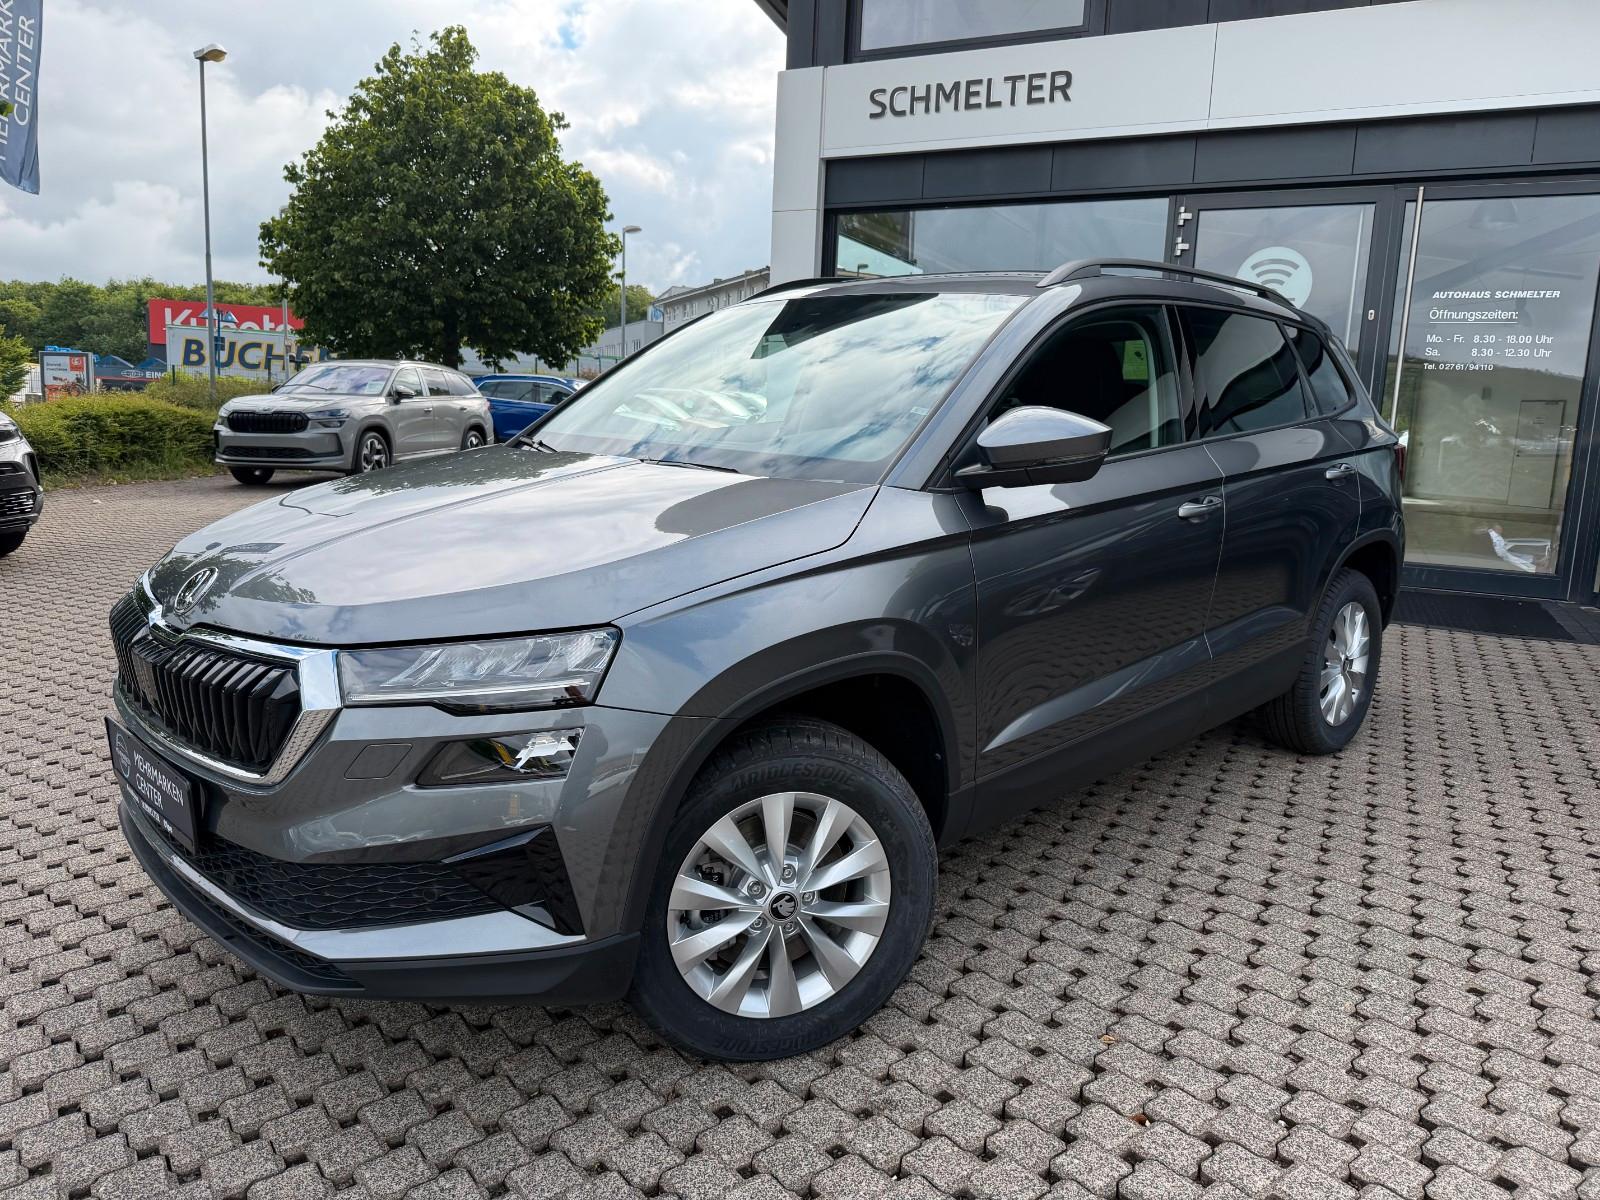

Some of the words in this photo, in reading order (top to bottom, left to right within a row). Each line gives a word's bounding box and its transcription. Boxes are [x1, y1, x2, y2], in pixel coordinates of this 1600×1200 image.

[13, 15, 35, 126] CENTER
[869, 70, 1073, 119] SCHMELTER
[1432, 290, 1491, 299] AUTOHAUS
[1494, 290, 1561, 299] SCHMELTER
[1429, 307, 1519, 322] Öffnungszeiten:
[1426, 334, 1444, 343] Mo.
[1453, 334, 1465, 343] Fr.
[1473, 334, 1496, 344] 8.30
[1506, 334, 1532, 344] 18.00
[1535, 334, 1554, 344] Uhr
[1424, 347, 1441, 356] Sa.
[1471, 348, 1494, 357] 8.30
[1504, 348, 1530, 357] 12.30
[1533, 348, 1552, 358] Uhr
[1423, 362, 1437, 370] Tel.
[133, 750, 184, 806] MEHRMARKEN
[135, 774, 164, 811] CENTER
